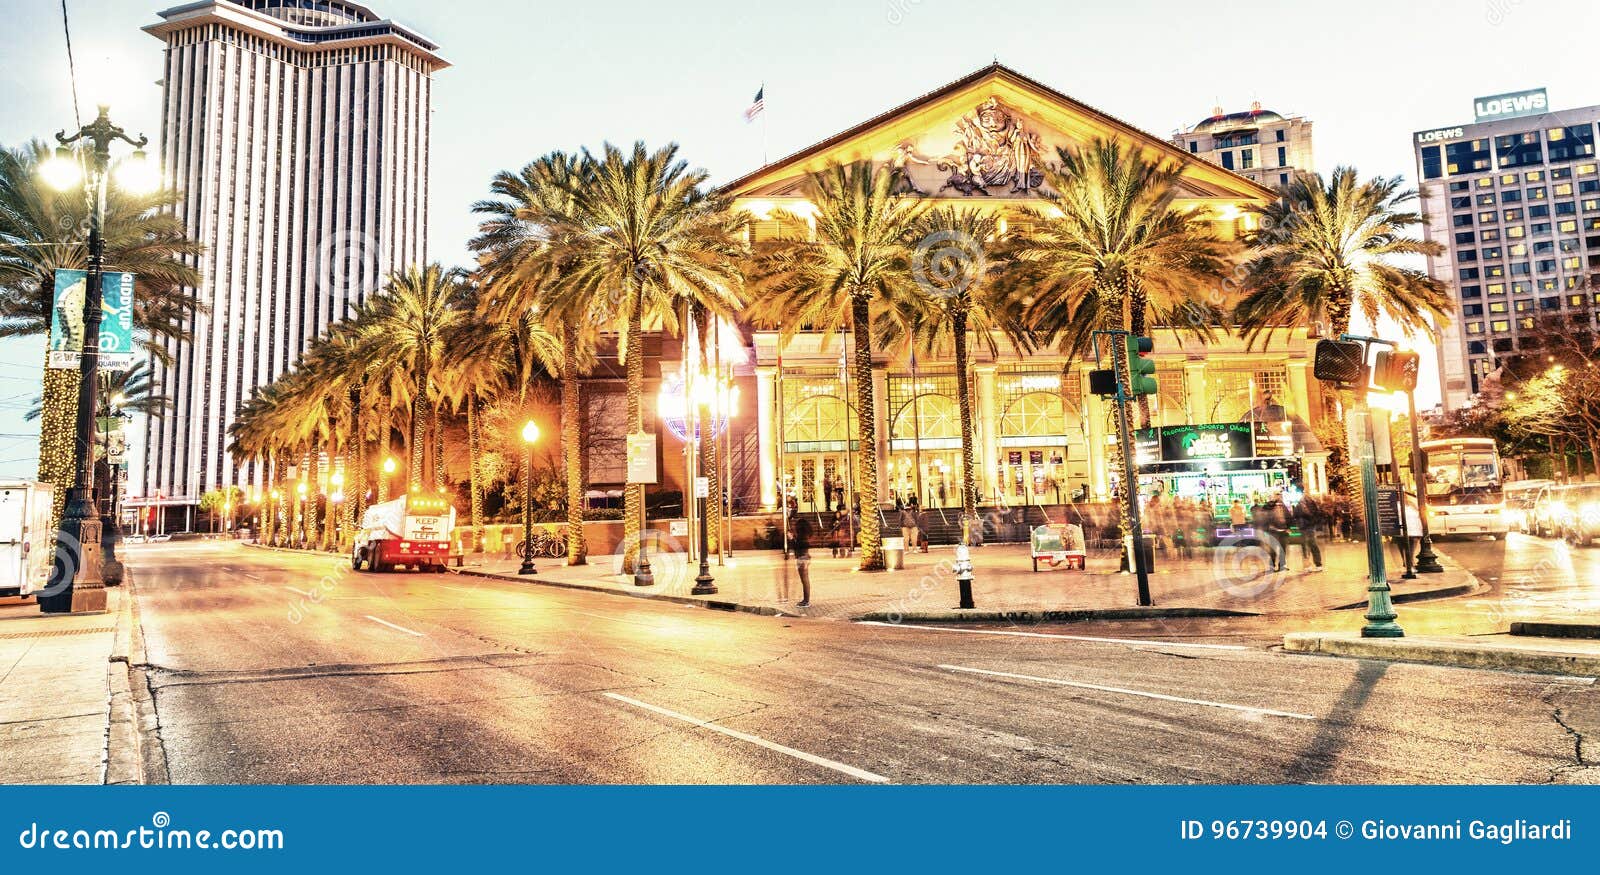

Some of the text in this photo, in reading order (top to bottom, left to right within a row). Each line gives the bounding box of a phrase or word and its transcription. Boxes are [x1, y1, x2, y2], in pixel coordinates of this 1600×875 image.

[1476, 93, 1546, 117] LOEWS
[1418, 127, 1464, 142] LOEWS
[119, 273, 133, 330] GIDDYUP
[1198, 423, 1225, 431] SPORTS
[415, 517, 438, 525] KEEP
